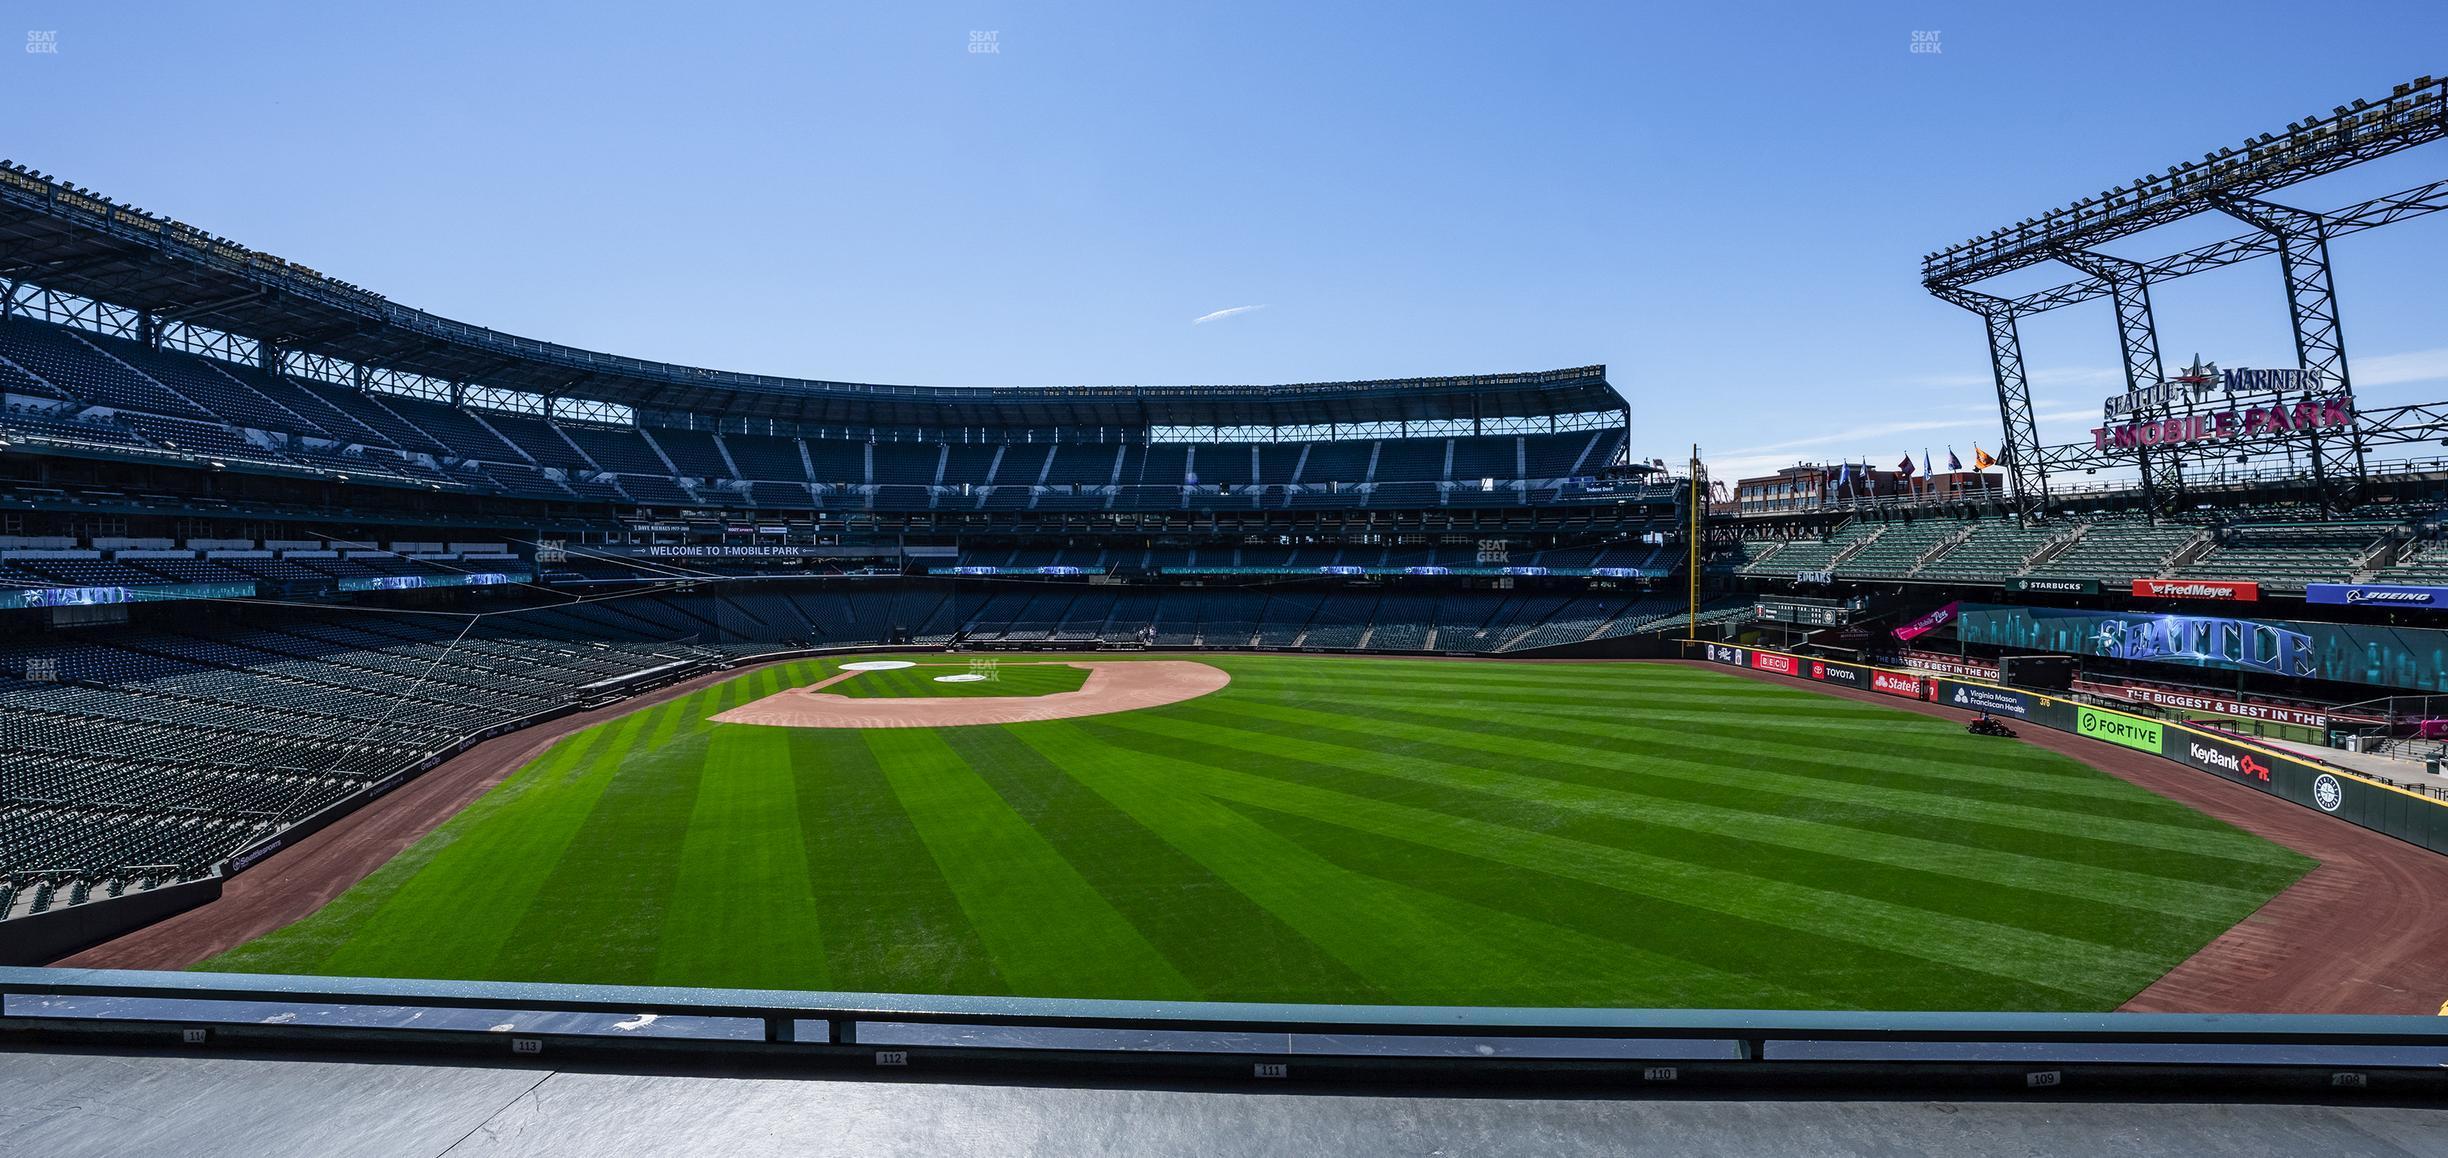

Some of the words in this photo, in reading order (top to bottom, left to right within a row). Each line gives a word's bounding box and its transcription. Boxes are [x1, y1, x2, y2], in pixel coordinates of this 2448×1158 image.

[2104, 381, 2178, 419] SEATTLE
[2223, 367, 2323, 393] MARINERS
[2090, 410, 2238, 452] T-MOBILE
[2245, 395, 2356, 436] PARK
[650, 546, 702, 556] WELCOME
[706, 546, 720, 556] TO
[724, 546, 770, 556] T-MOBILE
[773, 546, 799, 556] PARK
[2030, 582, 2080, 590] STARBUCKS
[2366, 592, 2430, 601] BOEING
[2095, 615, 2316, 679] SEATTLE
[1762, 657, 1786, 669] BECU
[1931, 662, 1954, 672] BEST
[1964, 667, 1982, 676] THE
[1826, 668, 1855, 680] TOYOTA
[1970, 690, 1994, 700] Virginia
[1994, 694, 2017, 704] Mason
[2040, 697, 2050, 708] 376
[1970, 697, 2004, 710] Franciscan
[2005, 703, 2024, 714] Health
[2154, 694, 2211, 710] BIGGEST
[2214, 702, 2224, 712] &
[2230, 704, 2268, 718] BEST
[2272, 710, 2288, 721] IN
[2293, 712, 2326, 726] THE
[2100, 720, 2156, 744] FORTIVE
[2190, 742, 2240, 772] KeyBank
[520, 1042, 536, 1050] 113
[884, 1054, 901, 1064] 112
[1262, 1066, 1280, 1076] 111
[1652, 1069, 1670, 1079] 110
[2036, 1074, 2054, 1084] 109
[2340, 1074, 2360, 1086] 108
